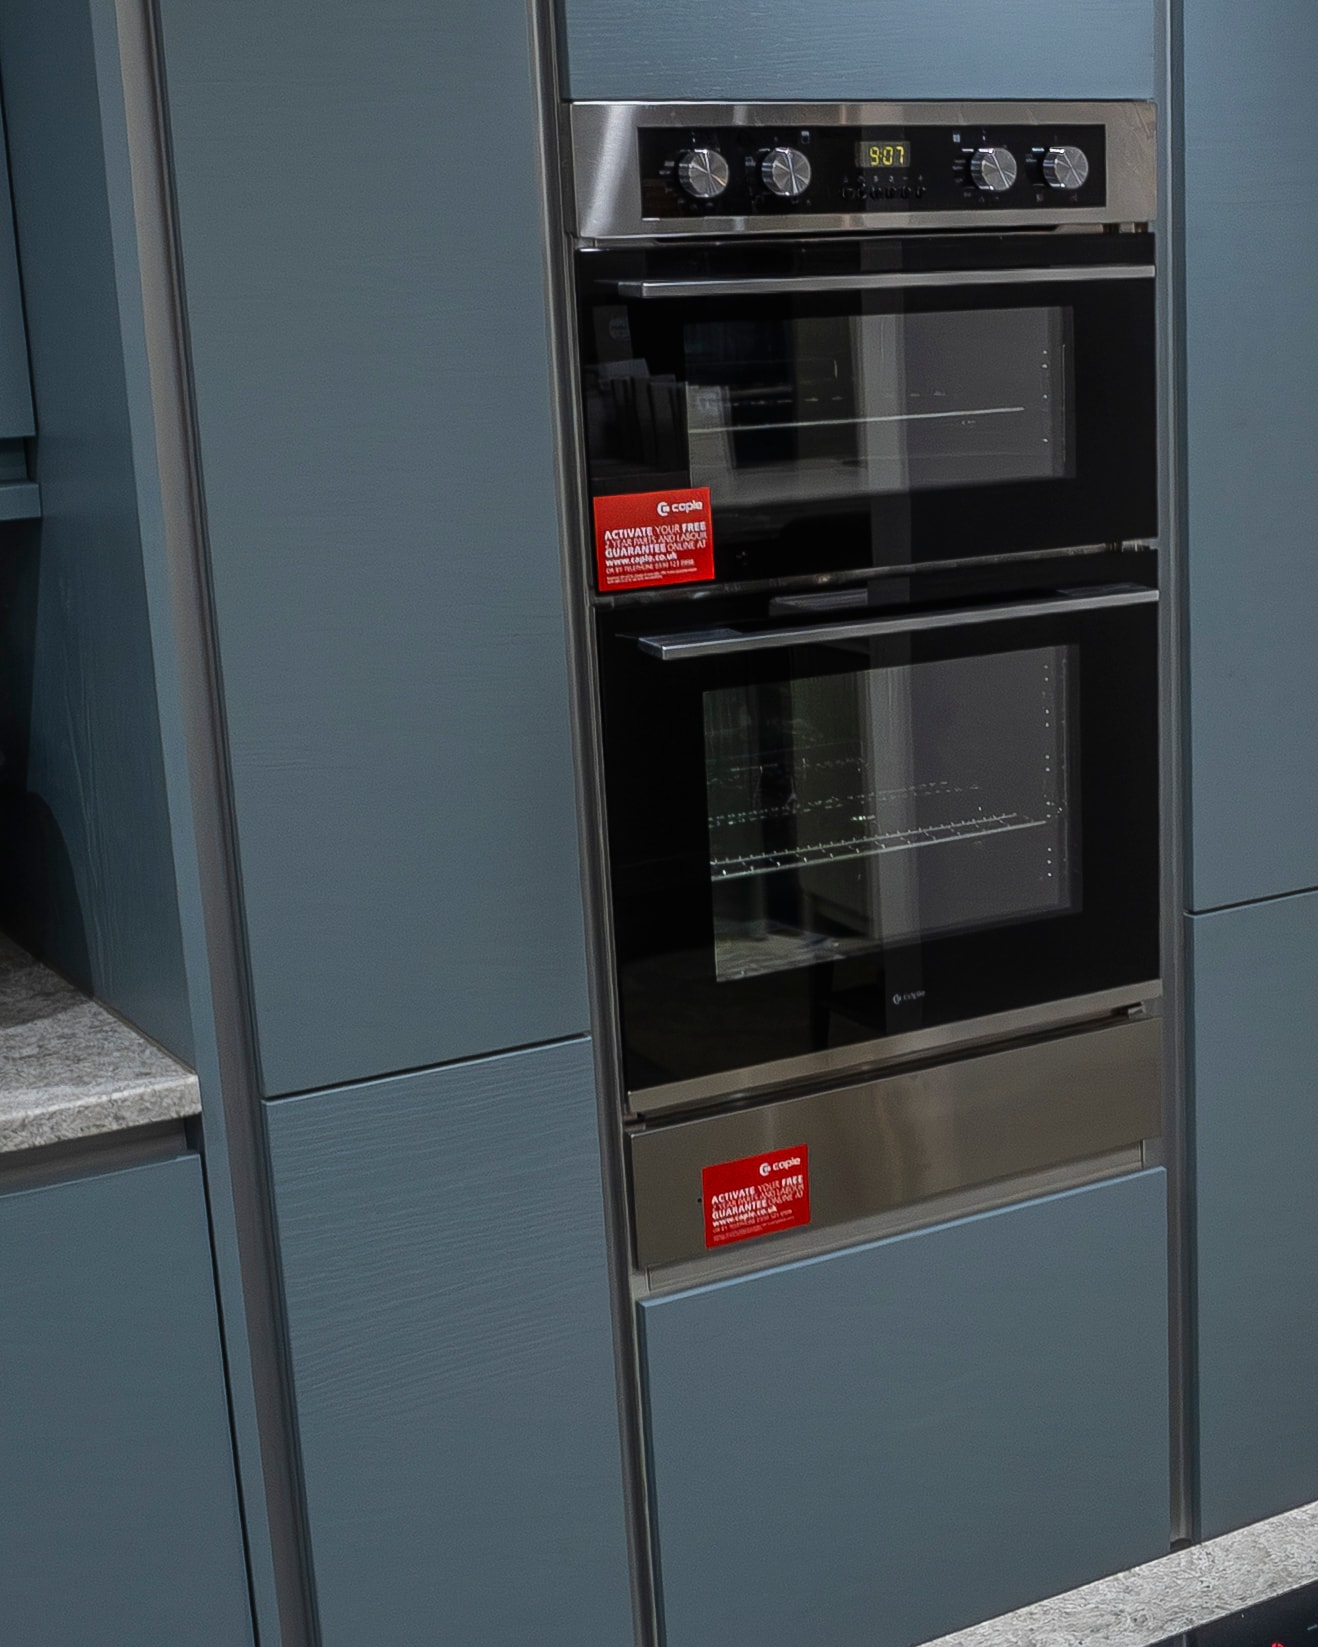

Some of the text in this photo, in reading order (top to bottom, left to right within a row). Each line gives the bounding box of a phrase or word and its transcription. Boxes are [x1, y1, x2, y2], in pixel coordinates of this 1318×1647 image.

[604, 521, 706, 540] ACTIVATE YOUR FREE
[605, 543, 666, 558] GUARANTEE
[667, 541, 695, 552] ONLINE
[711, 1186, 755, 1205] ACTIVATE
[711, 1199, 767, 1220] GUARANTEE
